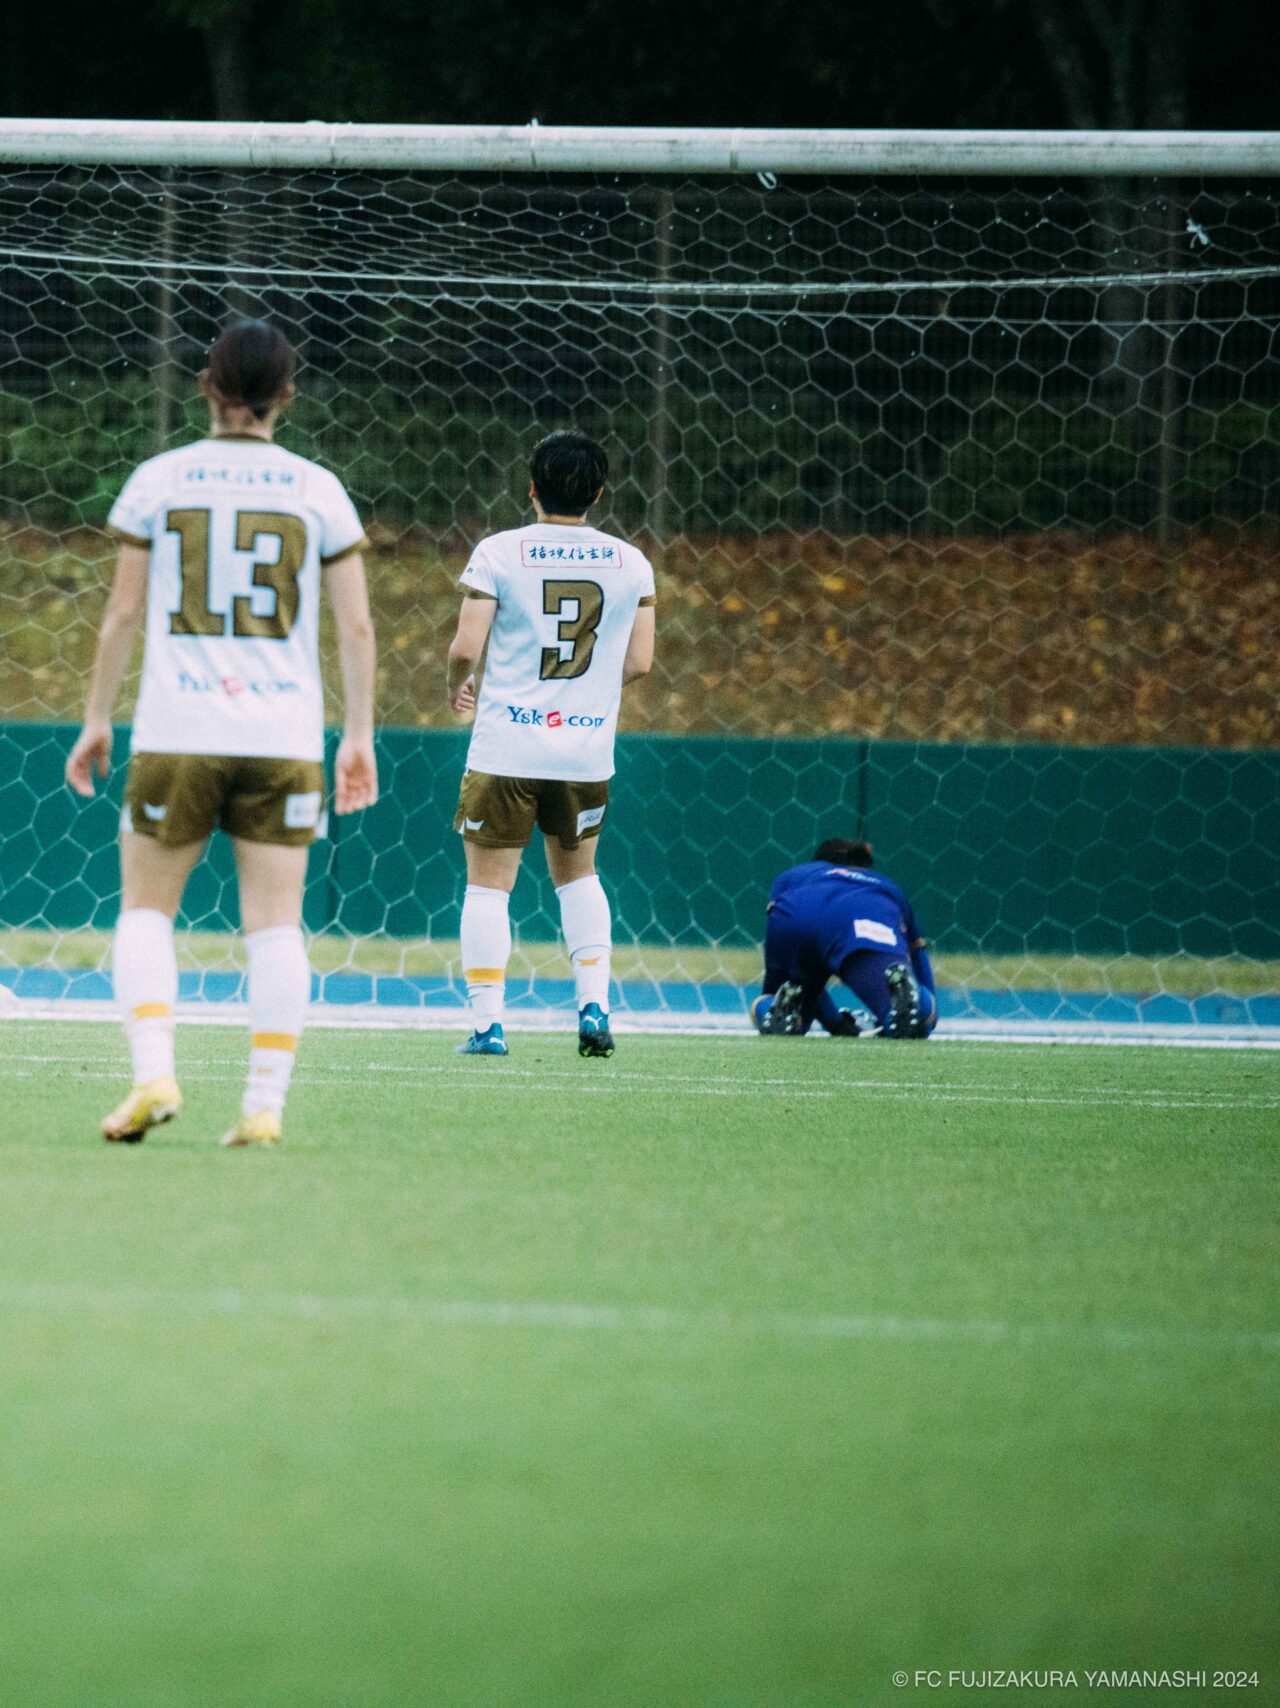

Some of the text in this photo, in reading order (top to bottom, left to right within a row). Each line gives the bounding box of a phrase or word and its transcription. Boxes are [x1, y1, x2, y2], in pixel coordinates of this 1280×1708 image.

[166, 508, 308, 639] 13
[539, 579, 604, 681] 3
[507, 705, 543, 726] Ysk
